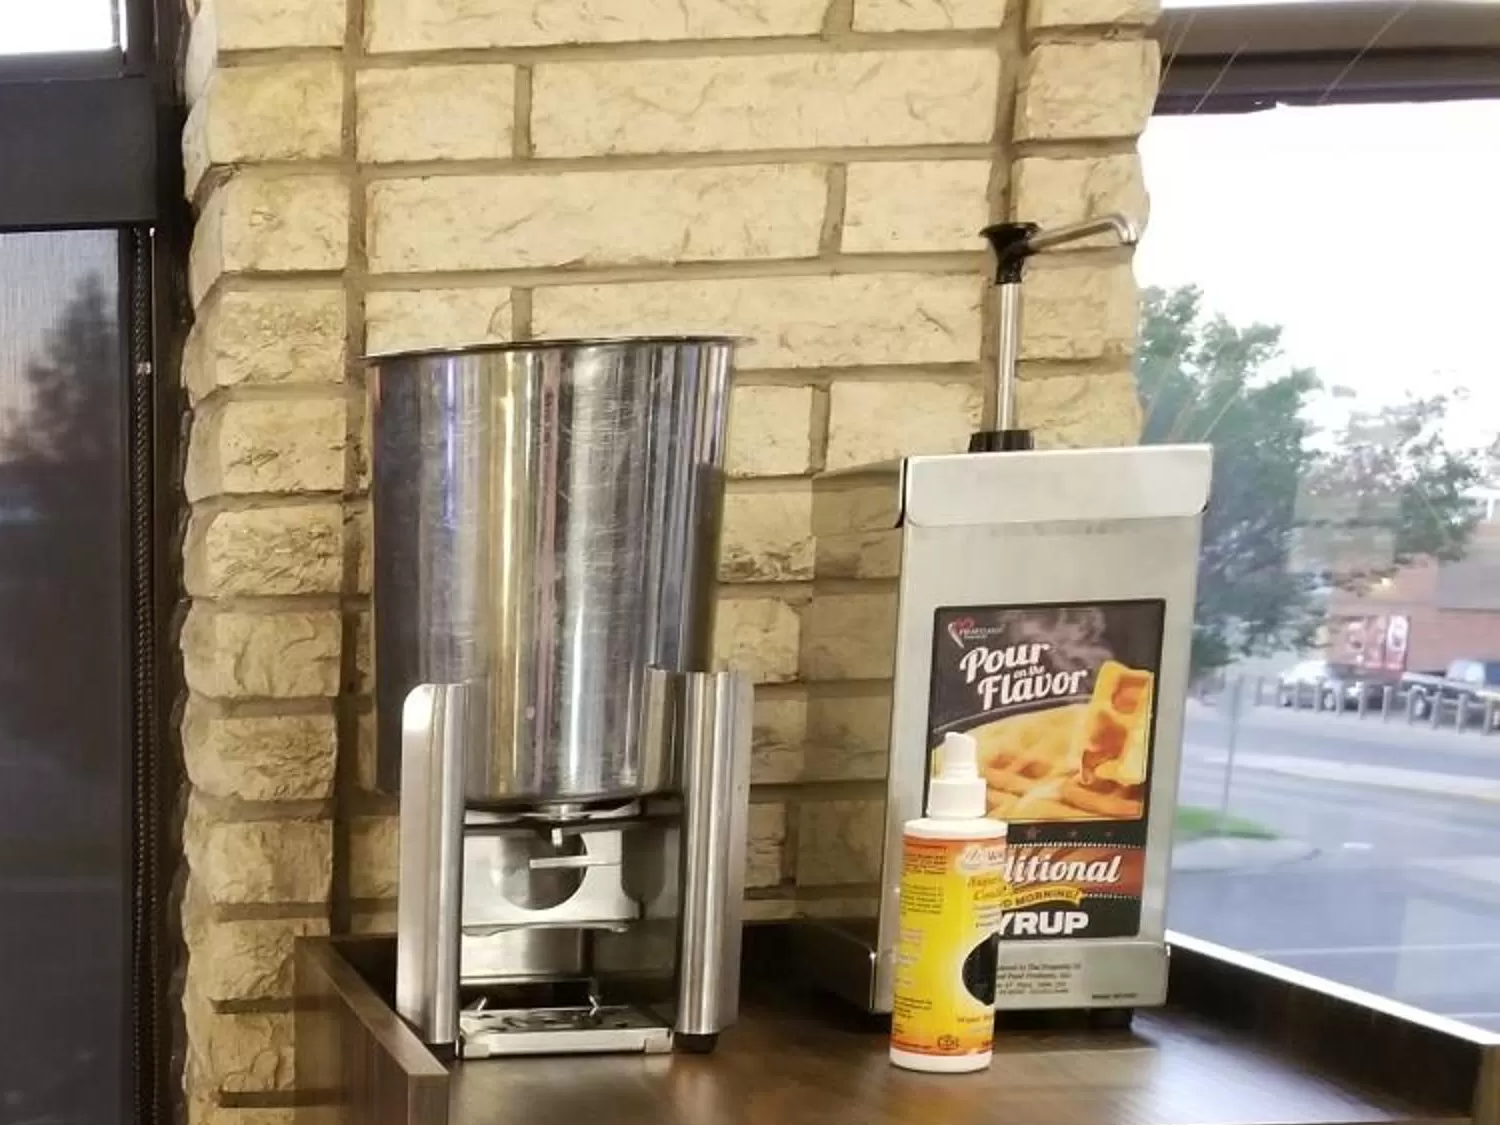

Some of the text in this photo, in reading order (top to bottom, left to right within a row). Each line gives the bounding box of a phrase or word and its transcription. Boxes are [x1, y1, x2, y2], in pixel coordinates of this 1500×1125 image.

[959, 643, 1051, 684] Pour
[977, 669, 1088, 711] Flavor
[1003, 854, 1122, 883] itional
[1000, 911, 1089, 935] YRUP
